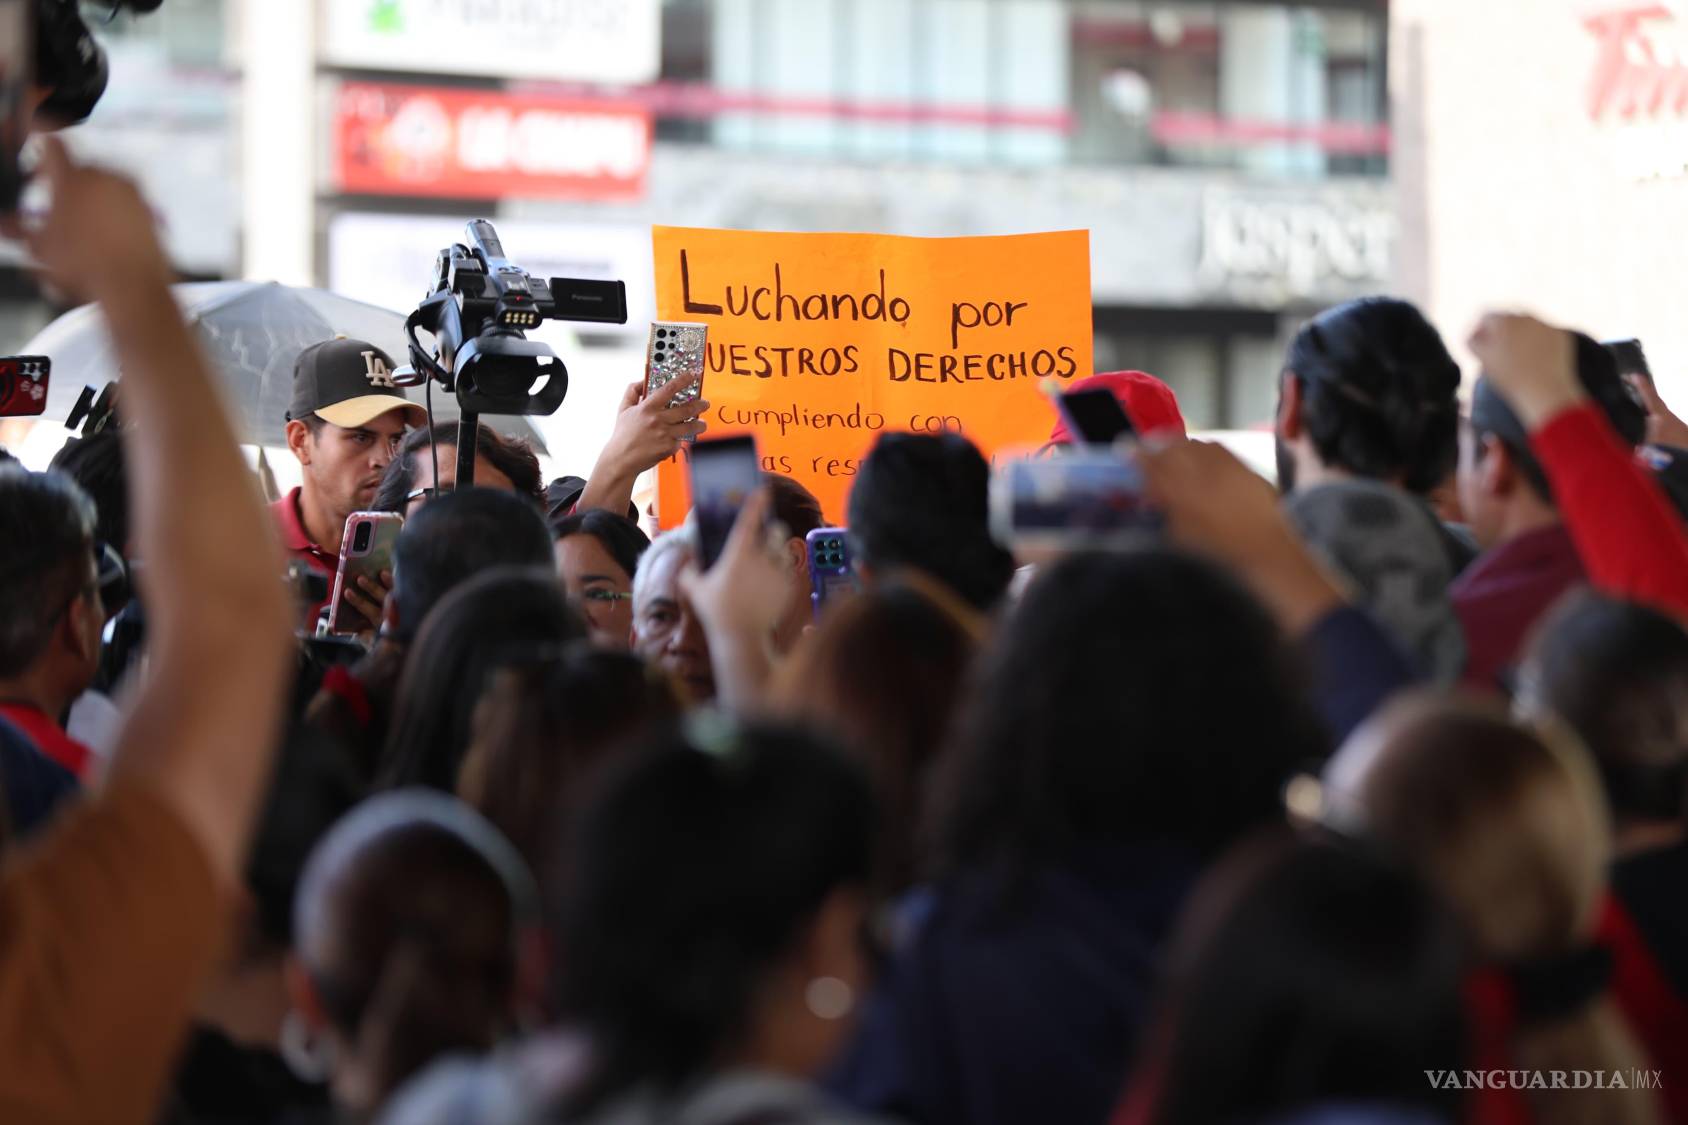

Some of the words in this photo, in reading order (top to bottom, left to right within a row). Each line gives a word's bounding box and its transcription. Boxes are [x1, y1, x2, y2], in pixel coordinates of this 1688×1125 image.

[680, 249, 910, 322] Luchando
[952, 302, 1028, 349] por
[361, 351, 394, 387] LA
[708, 342, 859, 379] UESTROS
[889, 347, 1077, 384] DERECHOS
[910, 414, 962, 433] con
